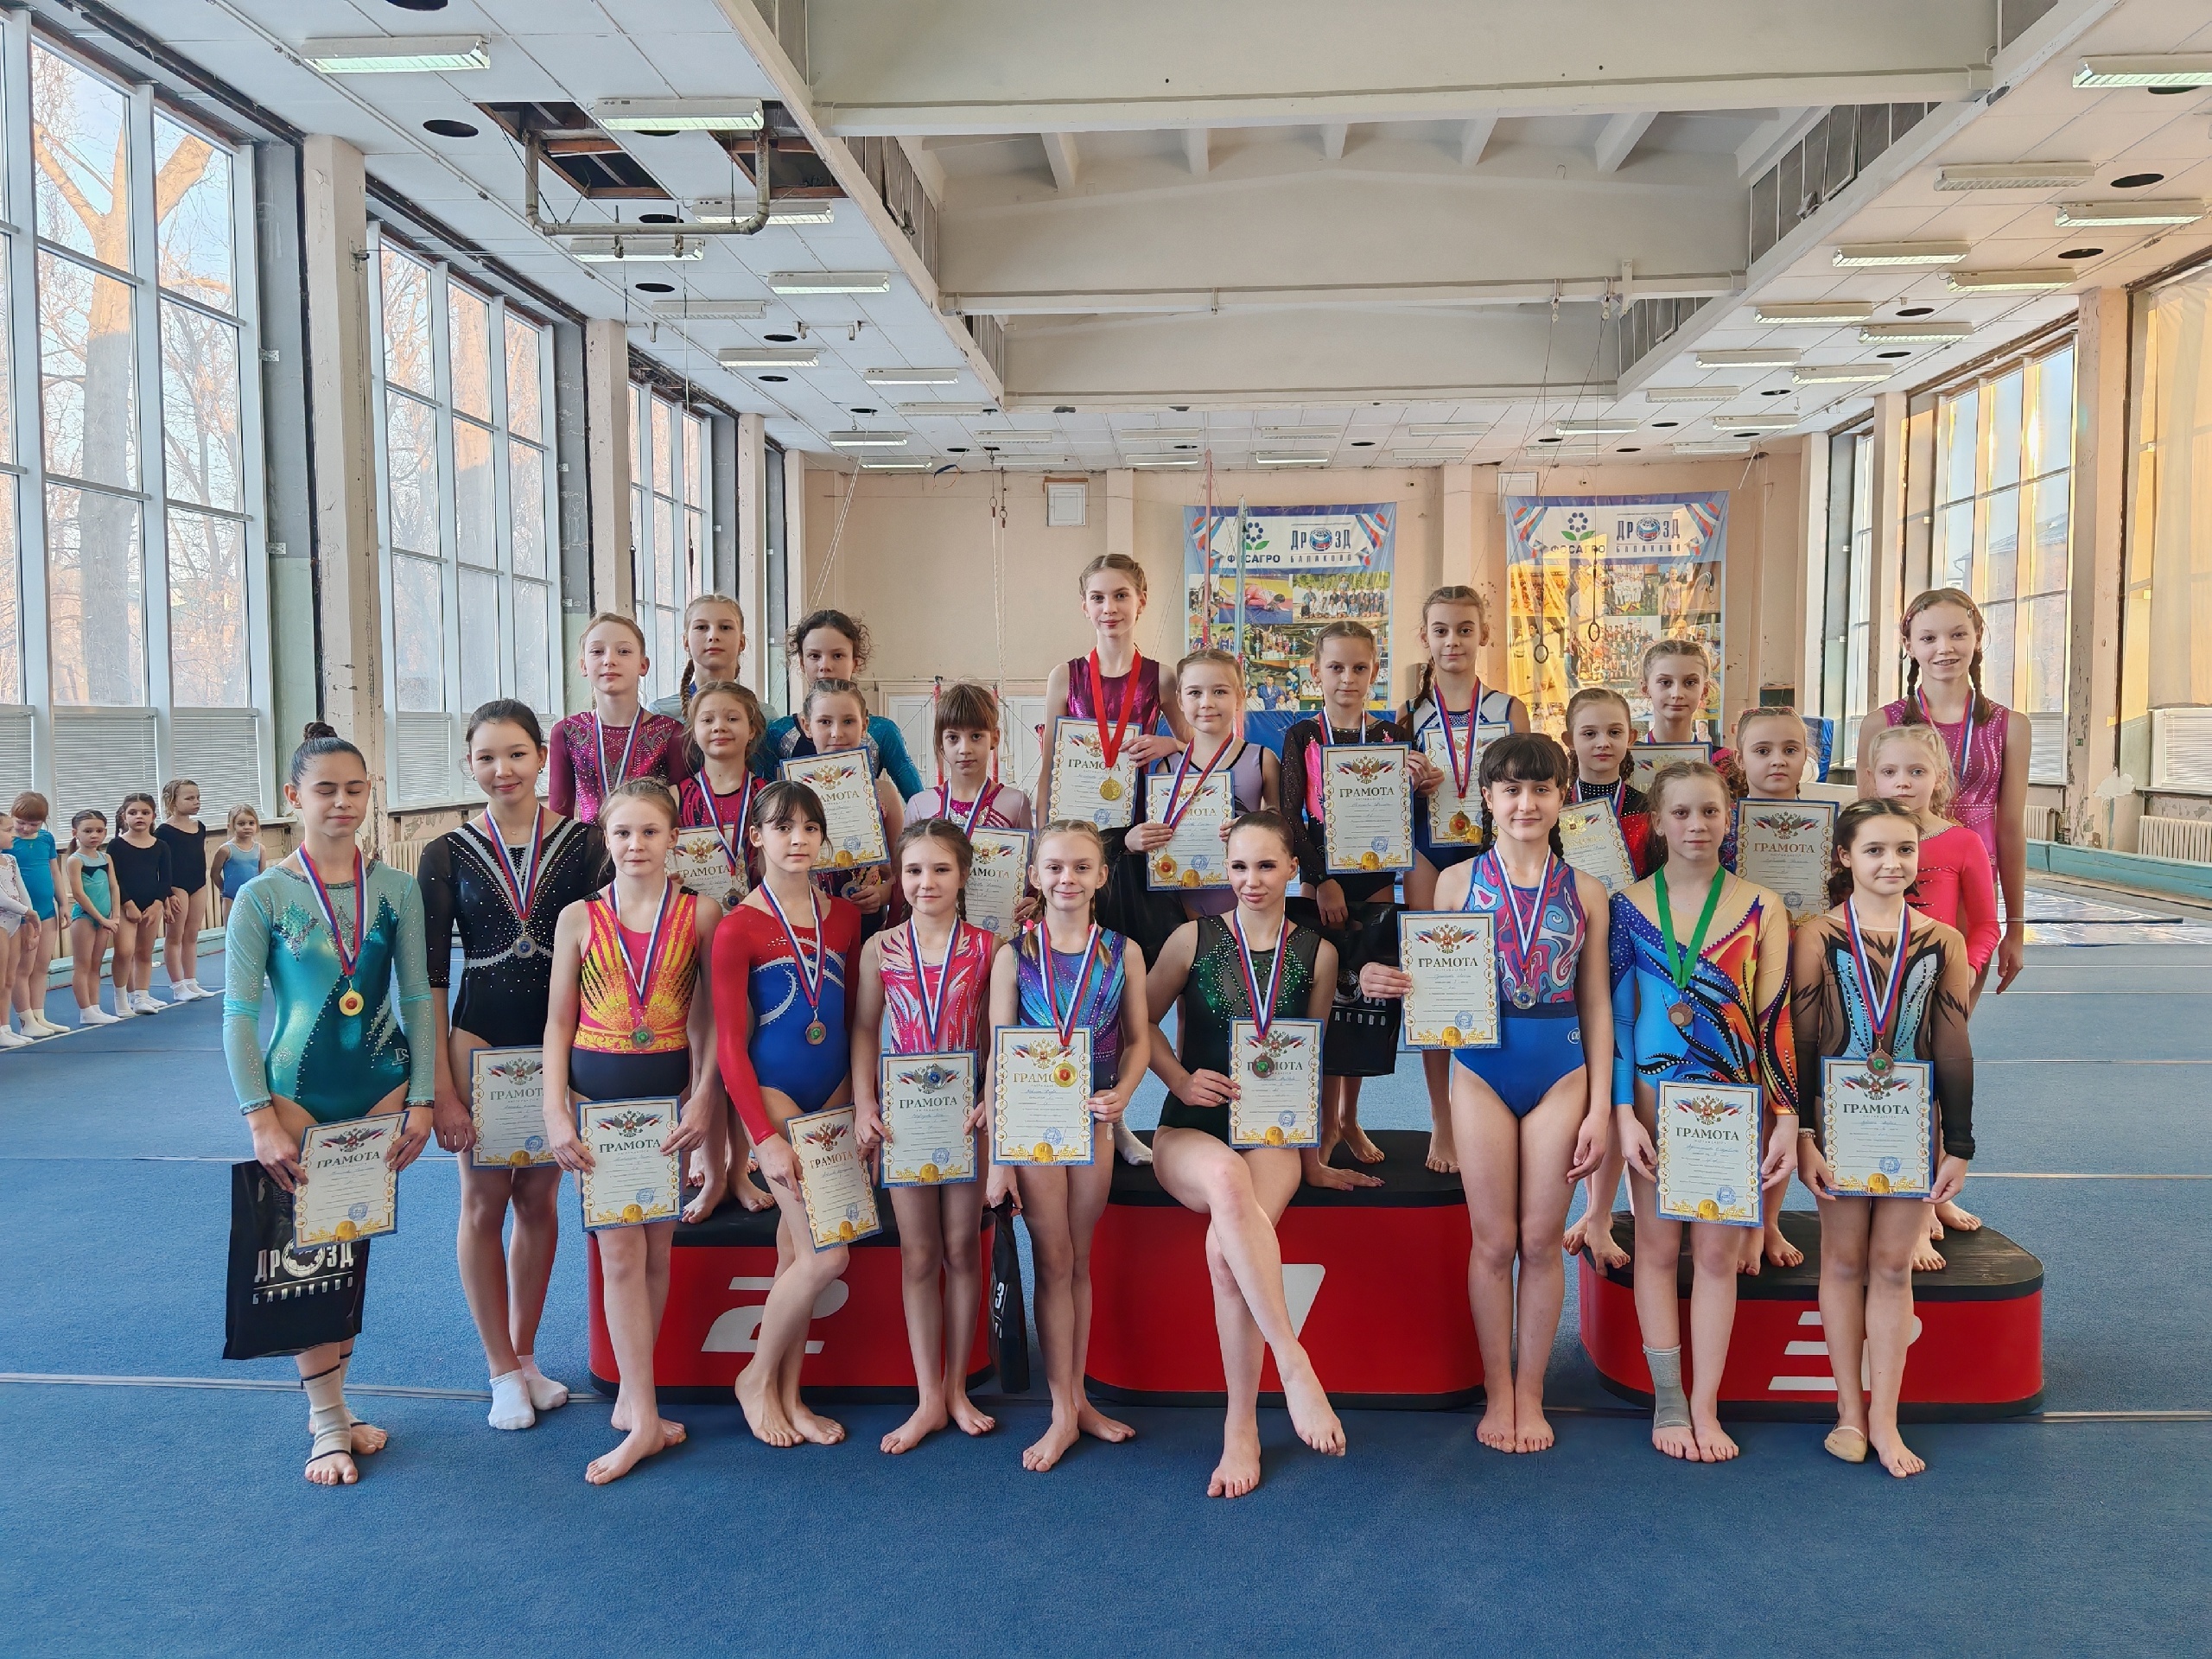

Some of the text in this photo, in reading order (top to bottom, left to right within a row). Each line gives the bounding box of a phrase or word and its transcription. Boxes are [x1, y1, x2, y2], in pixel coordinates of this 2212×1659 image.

[1227, 554, 1281, 563] ФСАГРО
[1068, 759, 1121, 772] ГРАМОА
[820, 790, 860, 802] АМОТА
[1339, 786, 1395, 798] ГРАМОТА
[1753, 842, 1815, 853] ГРАМОТА
[969, 867, 1010, 878] АМОТА
[1418, 957, 1478, 968] ГРАМОТА
[490, 1087, 544, 1101] ГРАМОТ
[899, 1096, 957, 1109] ГРАМОТА
[1843, 1103, 1910, 1115] ГРАМОТА
[1676, 1127, 1739, 1141] ГРАМОТА
[599, 1139, 661, 1153] ГРАМОТА
[316, 1151, 380, 1168] ГРАМОТА
[810, 1150, 854, 1169] ГРАМОТА
